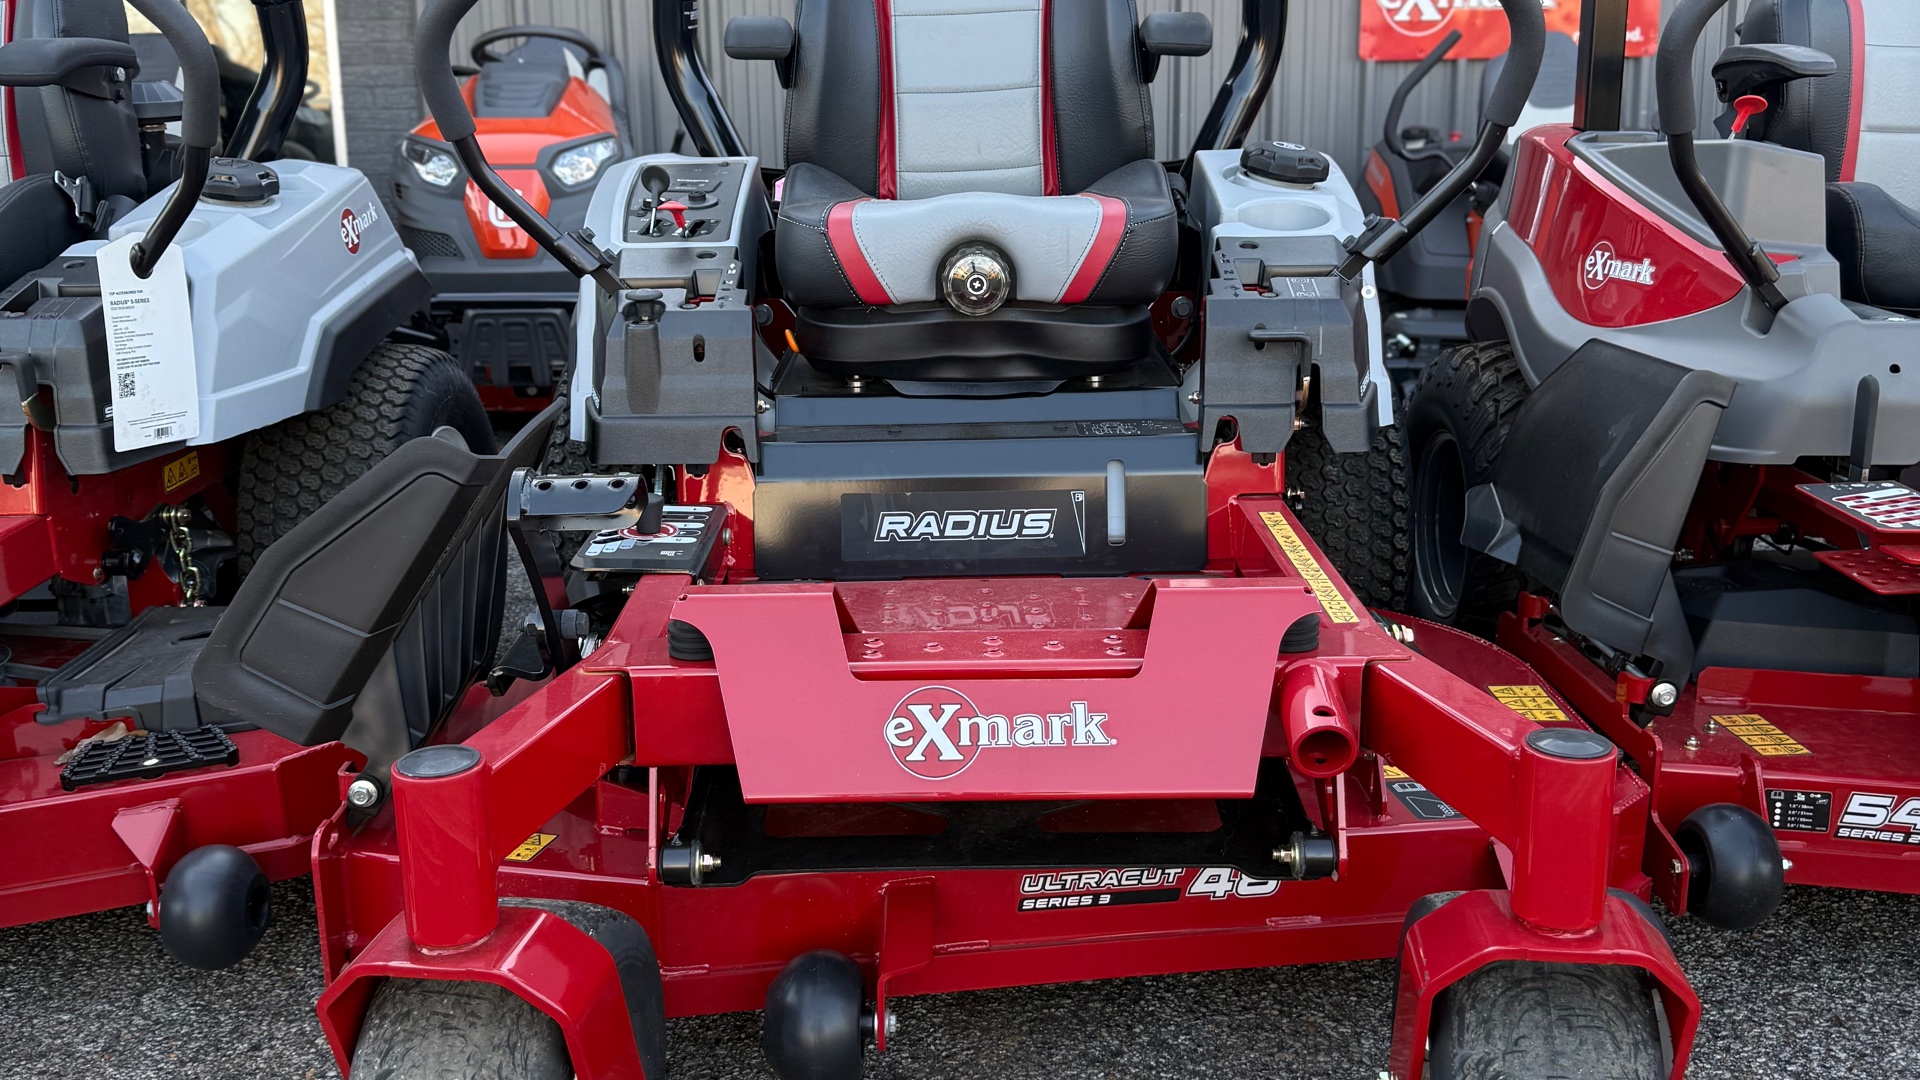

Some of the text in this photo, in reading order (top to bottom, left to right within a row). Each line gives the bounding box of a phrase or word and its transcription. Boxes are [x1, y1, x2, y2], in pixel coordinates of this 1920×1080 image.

[341, 202, 378, 249] eXmark
[1585, 248, 1656, 286] eXmark
[874, 508, 1058, 542] RADIUS
[883, 701, 1118, 762] eXmark
[1837, 828, 1905, 842] SERIES
[1020, 867, 1187, 894] ULTRACUT
[1022, 894, 1111, 910] SERIES 3
